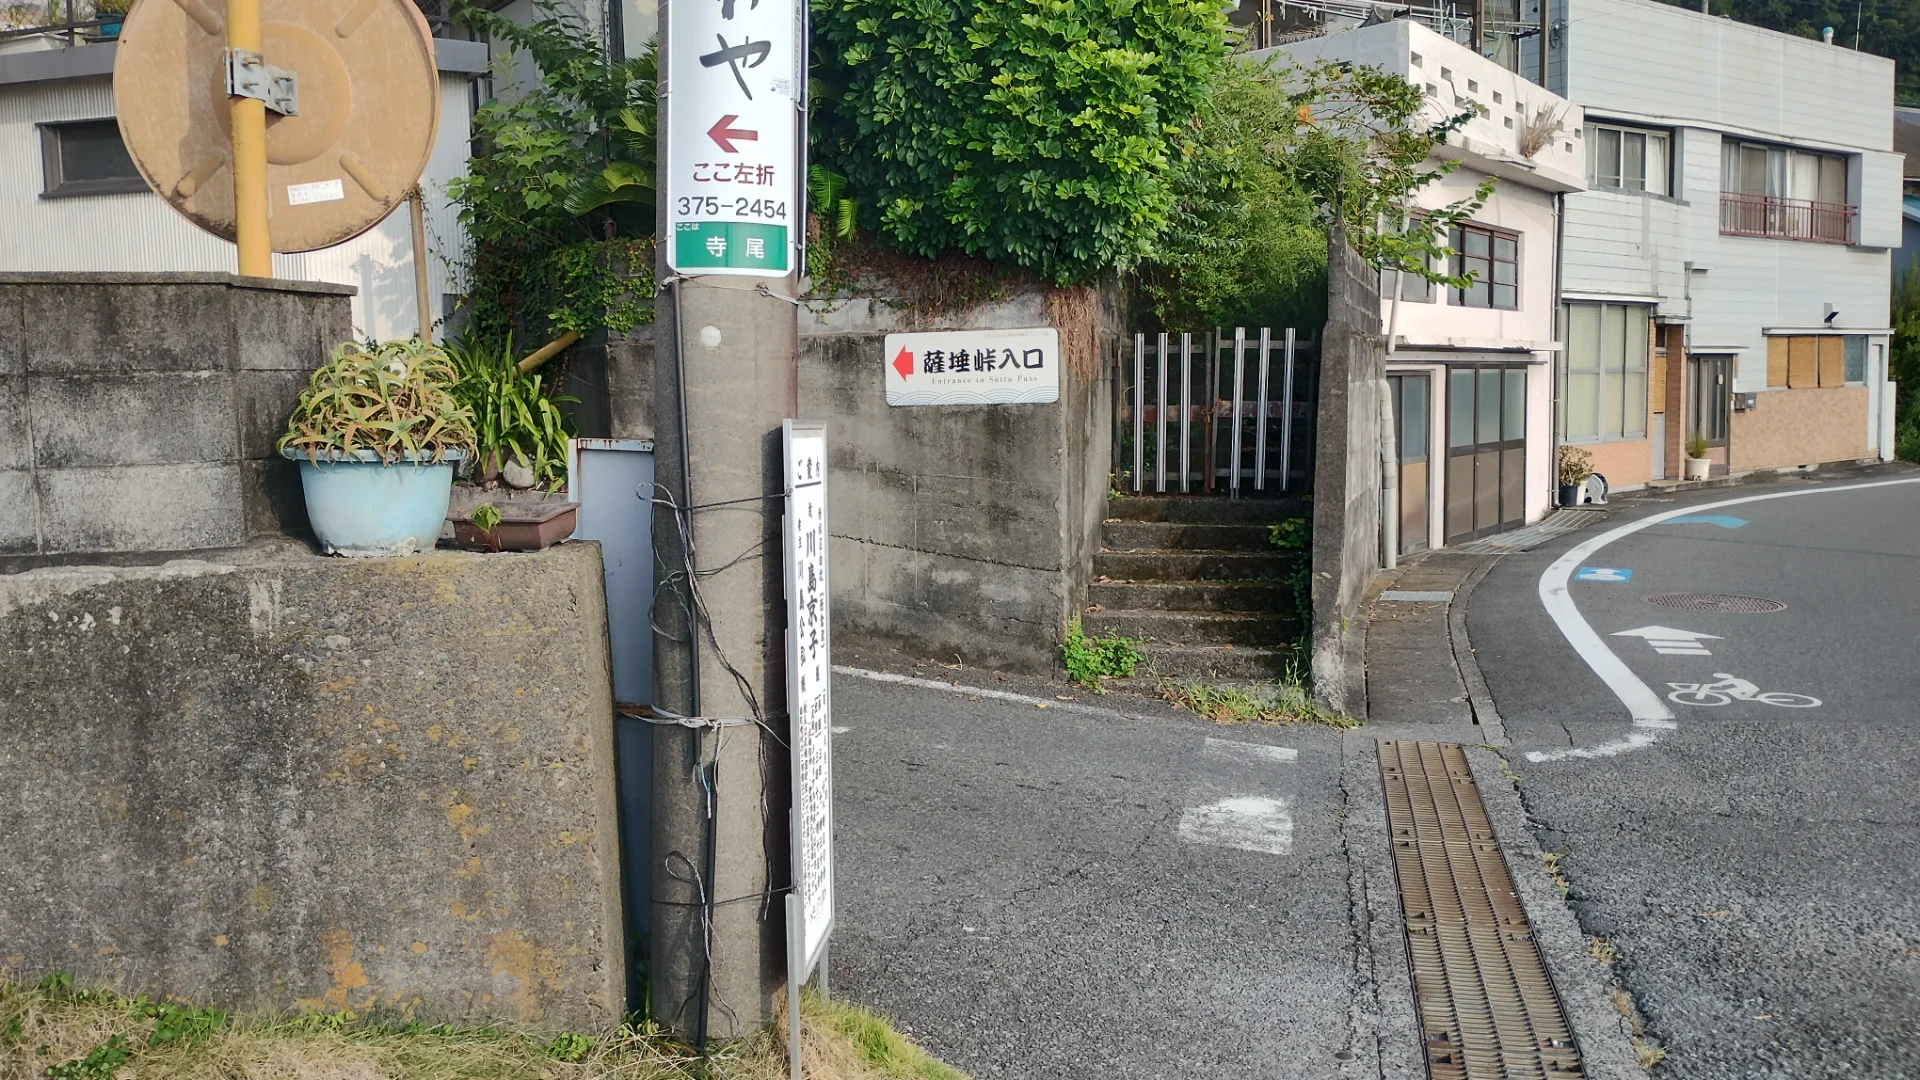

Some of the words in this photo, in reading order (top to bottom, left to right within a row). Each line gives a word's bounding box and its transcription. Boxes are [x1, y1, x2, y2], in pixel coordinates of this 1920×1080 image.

[693, 162, 775, 187] ここ左折
[678, 196, 787, 220] 375-2454
[676, 223, 700, 231] ここは
[932, 377, 972, 385] Entrance
[1017, 374, 1038, 382] Pass
